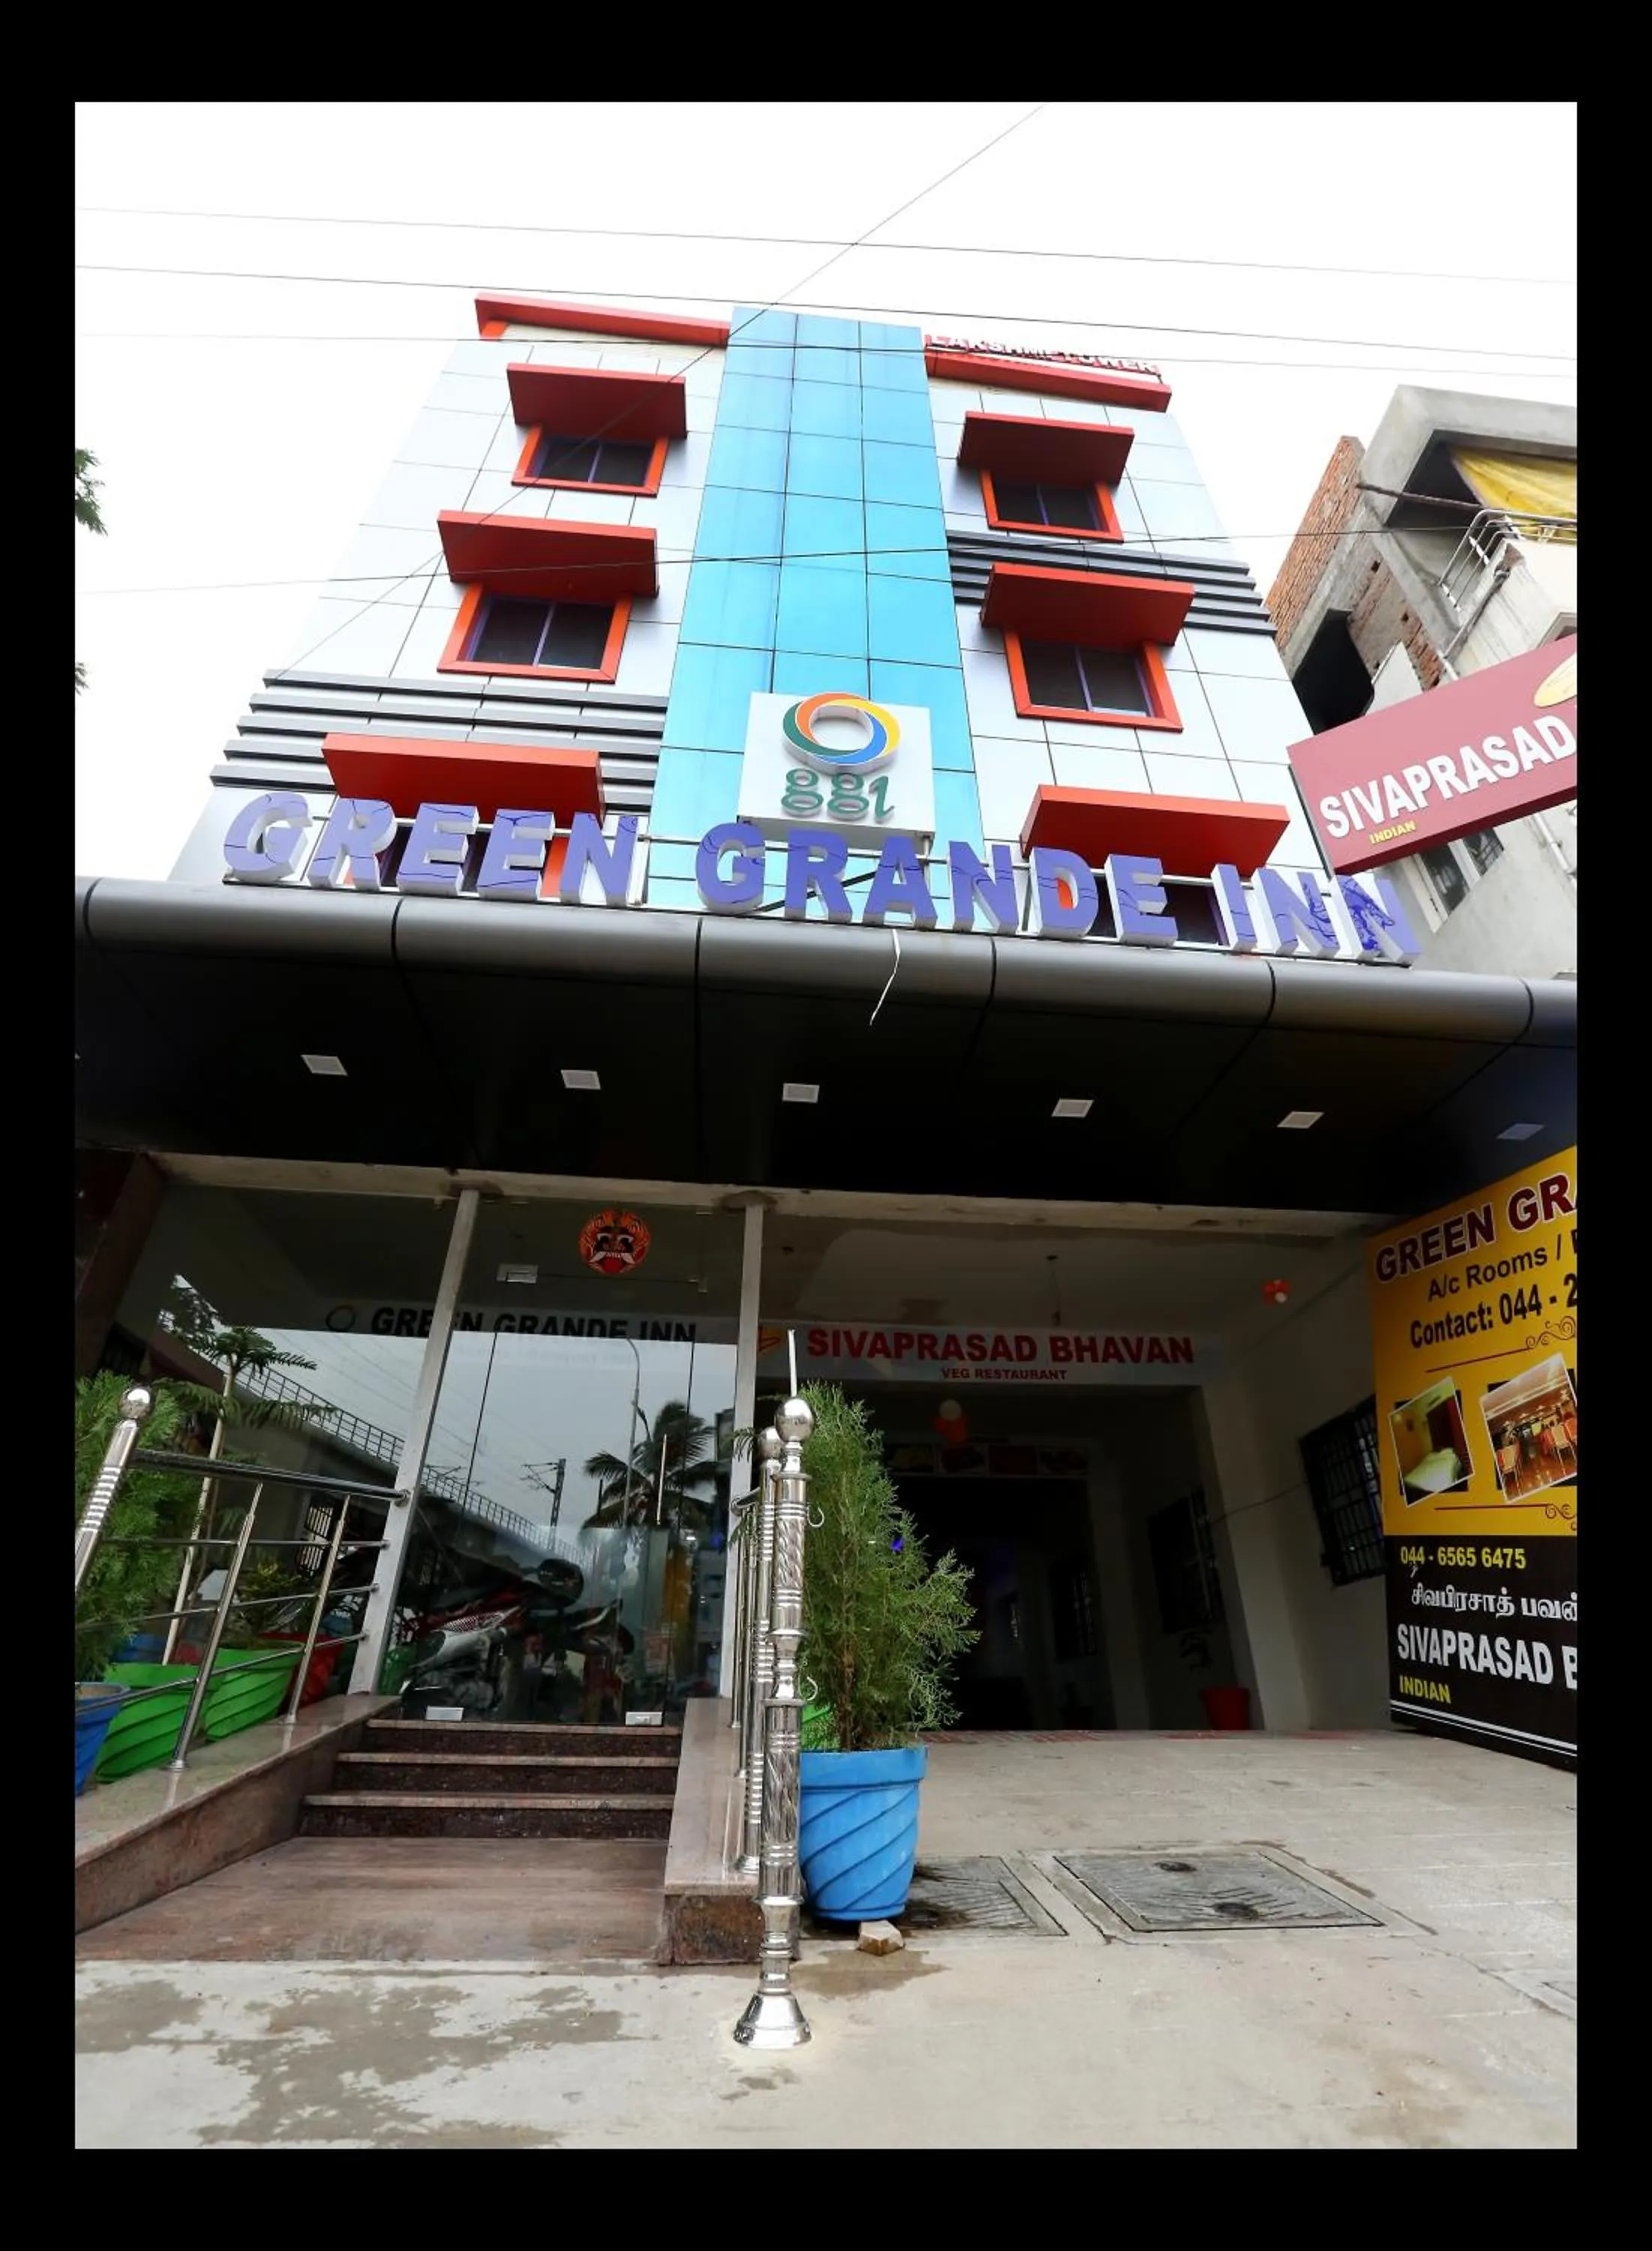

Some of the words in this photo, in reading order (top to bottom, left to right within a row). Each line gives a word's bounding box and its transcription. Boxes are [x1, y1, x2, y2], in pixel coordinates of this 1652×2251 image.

[1320, 714, 1577, 839] SIVAPRASAD
[1369, 821, 1416, 844] INDIAN
[223, 792, 644, 906] GREEN
[695, 822, 1178, 947] GRANDE
[1210, 864, 1421, 963] INN
[1375, 1202, 1496, 1285] GREEN
[1507, 1171, 1577, 1233] GR
[1427, 1273, 1460, 1302] A/c
[1466, 1246, 1548, 1289] Rooms
[372, 1306, 482, 1339] GREN
[494, 1314, 629, 1340] GRANDE
[640, 1321, 696, 1342] INN
[1410, 1302, 1493, 1349] Contact:
[1499, 1284, 1542, 1325] 044
[806, 1329, 1037, 1363] SIVAPRASAD
[1050, 1336, 1194, 1364] BHAVAN
[941, 1367, 970, 1380] VEG
[975, 1368, 1068, 1381] RESTAURANT
[1401, 1546, 1425, 1564] 044
[1437, 1546, 1476, 1567] 6565
[1481, 1548, 1527, 1569] 6475
[1397, 1624, 1554, 1685] SIVAPRASAD
[1398, 1675, 1452, 1704] INDIAN
